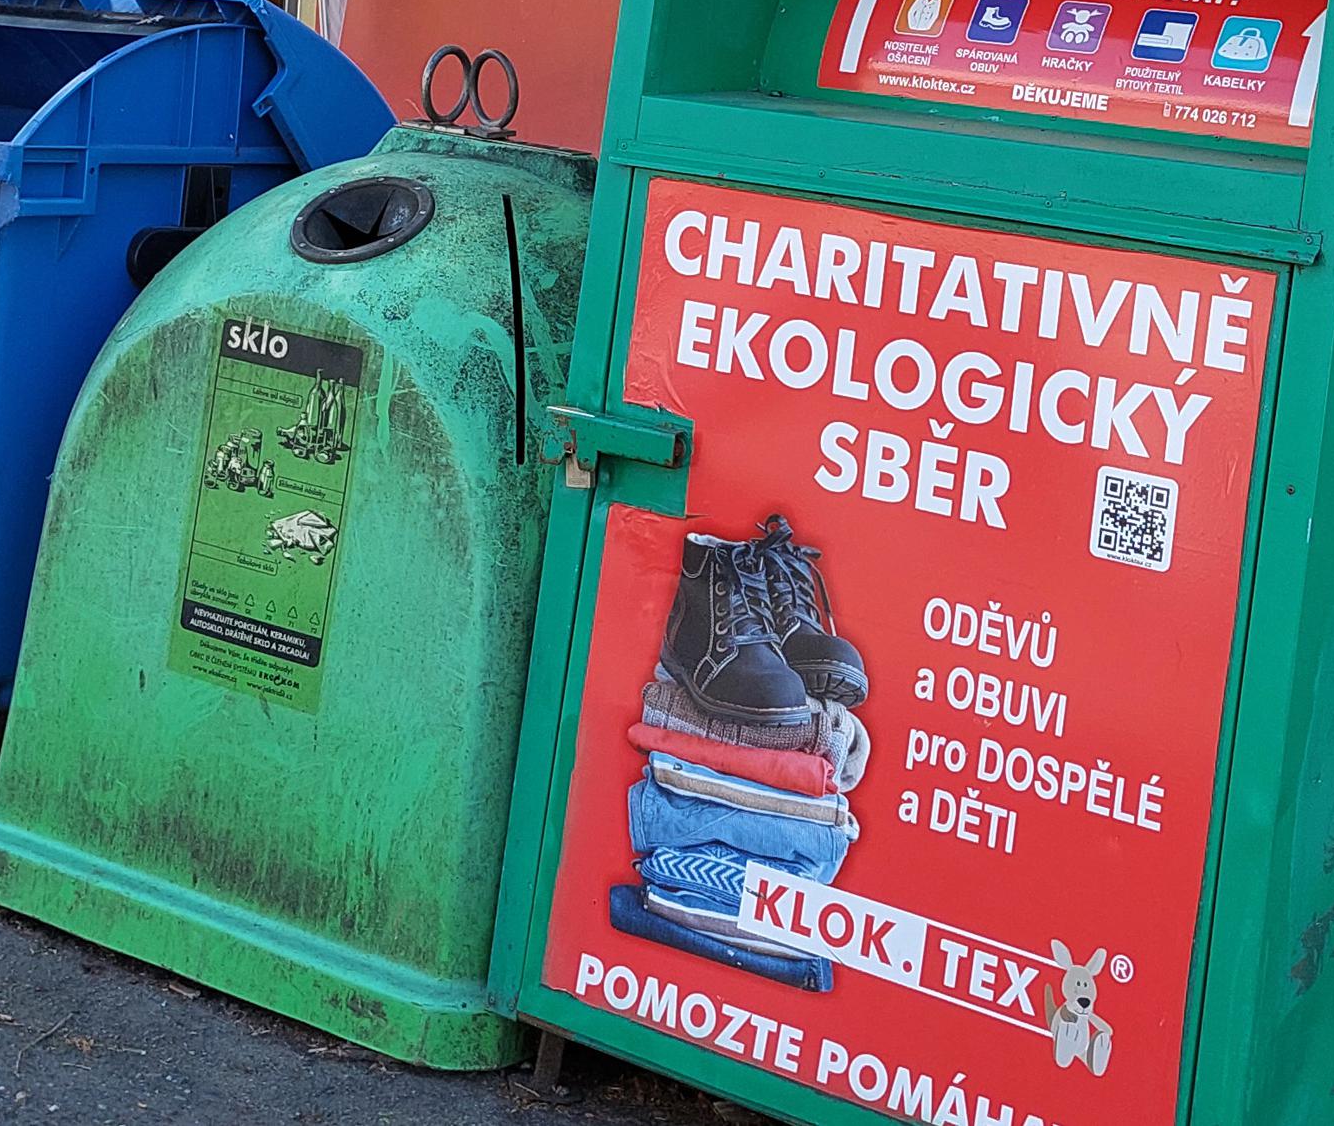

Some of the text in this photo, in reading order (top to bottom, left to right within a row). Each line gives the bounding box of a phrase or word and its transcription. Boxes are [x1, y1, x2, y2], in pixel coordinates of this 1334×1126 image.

[884, 40, 939, 55] NOSITELNÉ
[887, 52, 932, 66] OŠACENÍ
[955, 48, 1018, 64] SPÁROVANÁ
[970, 63, 999, 73] OBUV
[1042, 56, 1093, 72] HRAČKY
[1116, 78, 1184, 94] BYTOVÝ TEXTIL
[1124, 66, 1181, 82] POUŽITELNÝ
[1203, 74, 1265, 92] KABELKY
[878, 73, 1257, 128] www.kloktex.cz DĚKUJEME 774 026 712
[665, 210, 1253, 373] CHARITATIVNĚ
[227, 316, 288, 359] sklo
[675, 299, 1213, 466] EKOLOGICKÝ
[814, 419, 1011, 530] SBĚR
[253, 638, 271, 649] SKLO
[271, 642, 277, 650] A
[923, 596, 1058, 668] ODĚVŮ
[914, 666, 1068, 738] a OBUVI
[905, 727, 1166, 832] pro DOSPĚLÉ
[897, 785, 1017, 854] a DĚTI
[752, 878, 1041, 1017] KLOK. TEX
[575, 952, 1060, 1126] POMOZTE POMÁH
